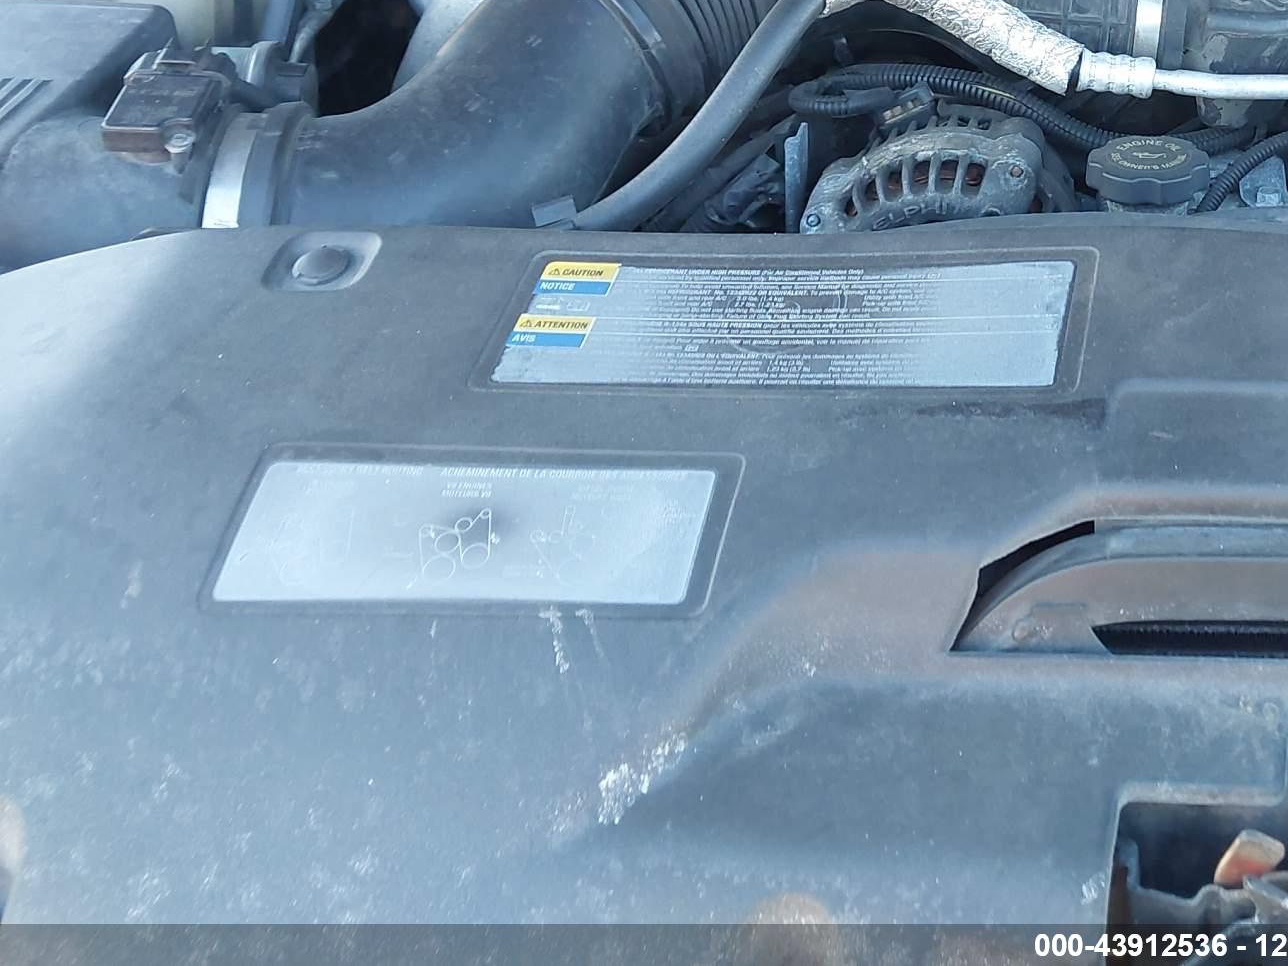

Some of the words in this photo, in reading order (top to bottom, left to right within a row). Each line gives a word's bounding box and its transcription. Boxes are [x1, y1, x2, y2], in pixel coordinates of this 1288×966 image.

[1116, 139, 1163, 152] ENGINE
[562, 268, 604, 277] CAUTION
[540, 281, 576, 291] NOTICE
[534, 320, 588, 330] ATTENTION
[511, 334, 537, 343] AVIS
